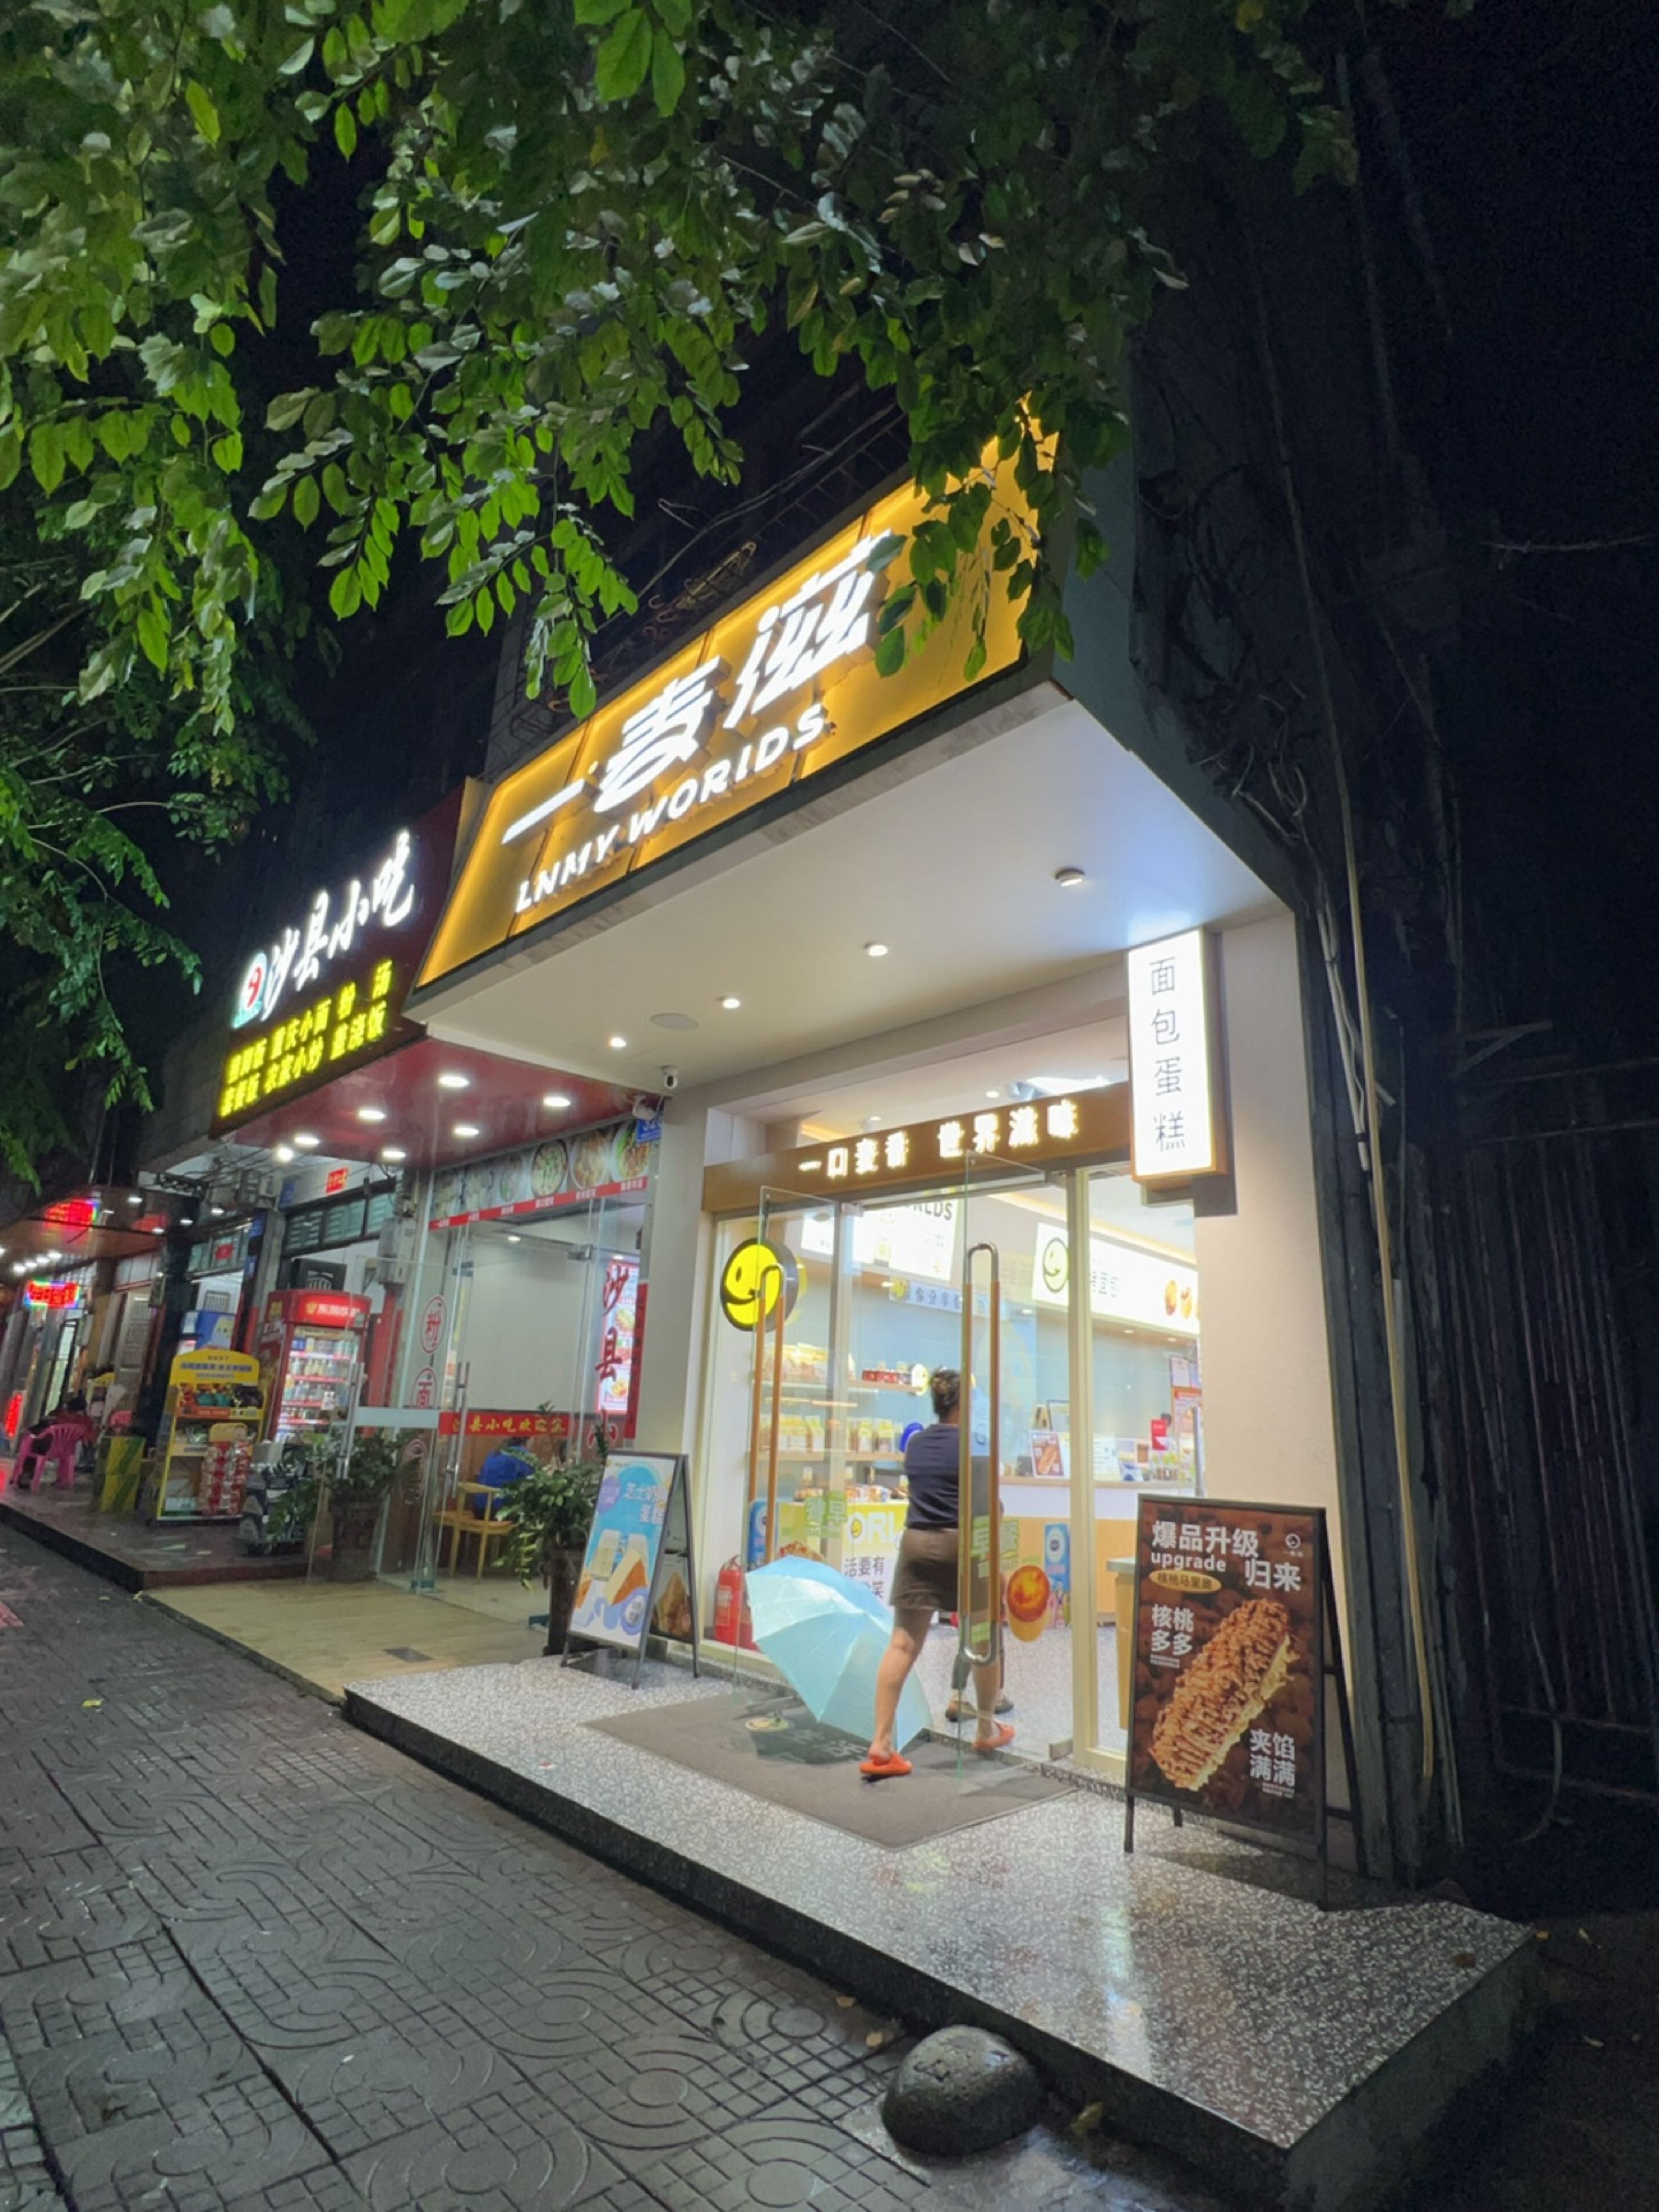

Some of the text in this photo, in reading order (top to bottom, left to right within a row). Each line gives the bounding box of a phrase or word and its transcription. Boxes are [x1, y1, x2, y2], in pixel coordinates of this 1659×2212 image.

[502, 529, 892, 845] 一麦滋
[260, 830, 415, 1022] 沙县小吃
[1150, 956, 1186, 1152] 面包蛋糕
[798, 1098, 1078, 1179] 一口麦香 世界滋味
[1152, 1521, 1259, 1558] 爆品升级
[1150, 1551, 1226, 1572] upgrade
[1245, 1558, 1301, 1592] 归来
[1151, 1603, 1194, 1633] 核桃
[1151, 1630, 1193, 1655] 多多
[1249, 1728, 1295, 1761] 夹馅
[1249, 1753, 1295, 1788] 满满
